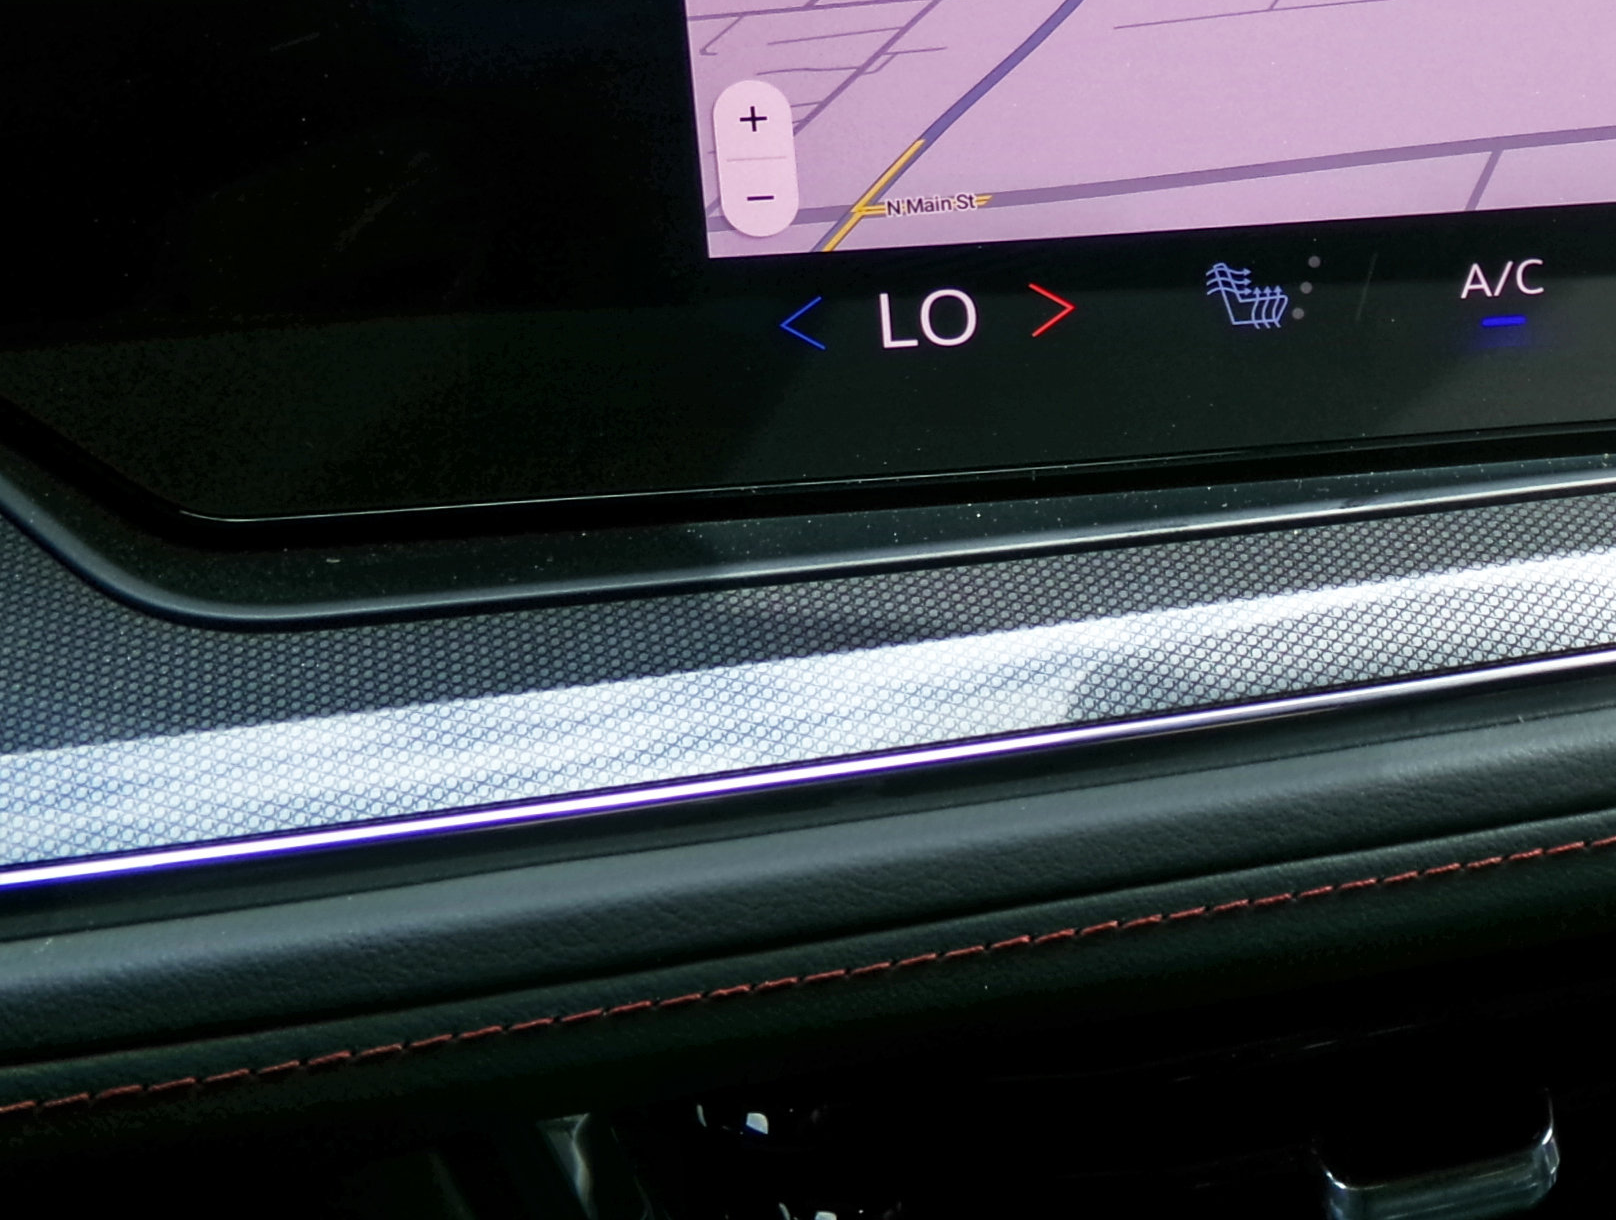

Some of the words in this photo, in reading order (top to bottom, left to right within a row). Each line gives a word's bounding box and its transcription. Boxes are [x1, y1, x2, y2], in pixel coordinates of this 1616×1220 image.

[887, 199, 903, 216] N
[907, 196, 948, 214] Main
[954, 193, 976, 210] St
[1460, 259, 1544, 299] A/C
[878, 289, 977, 349] LO
